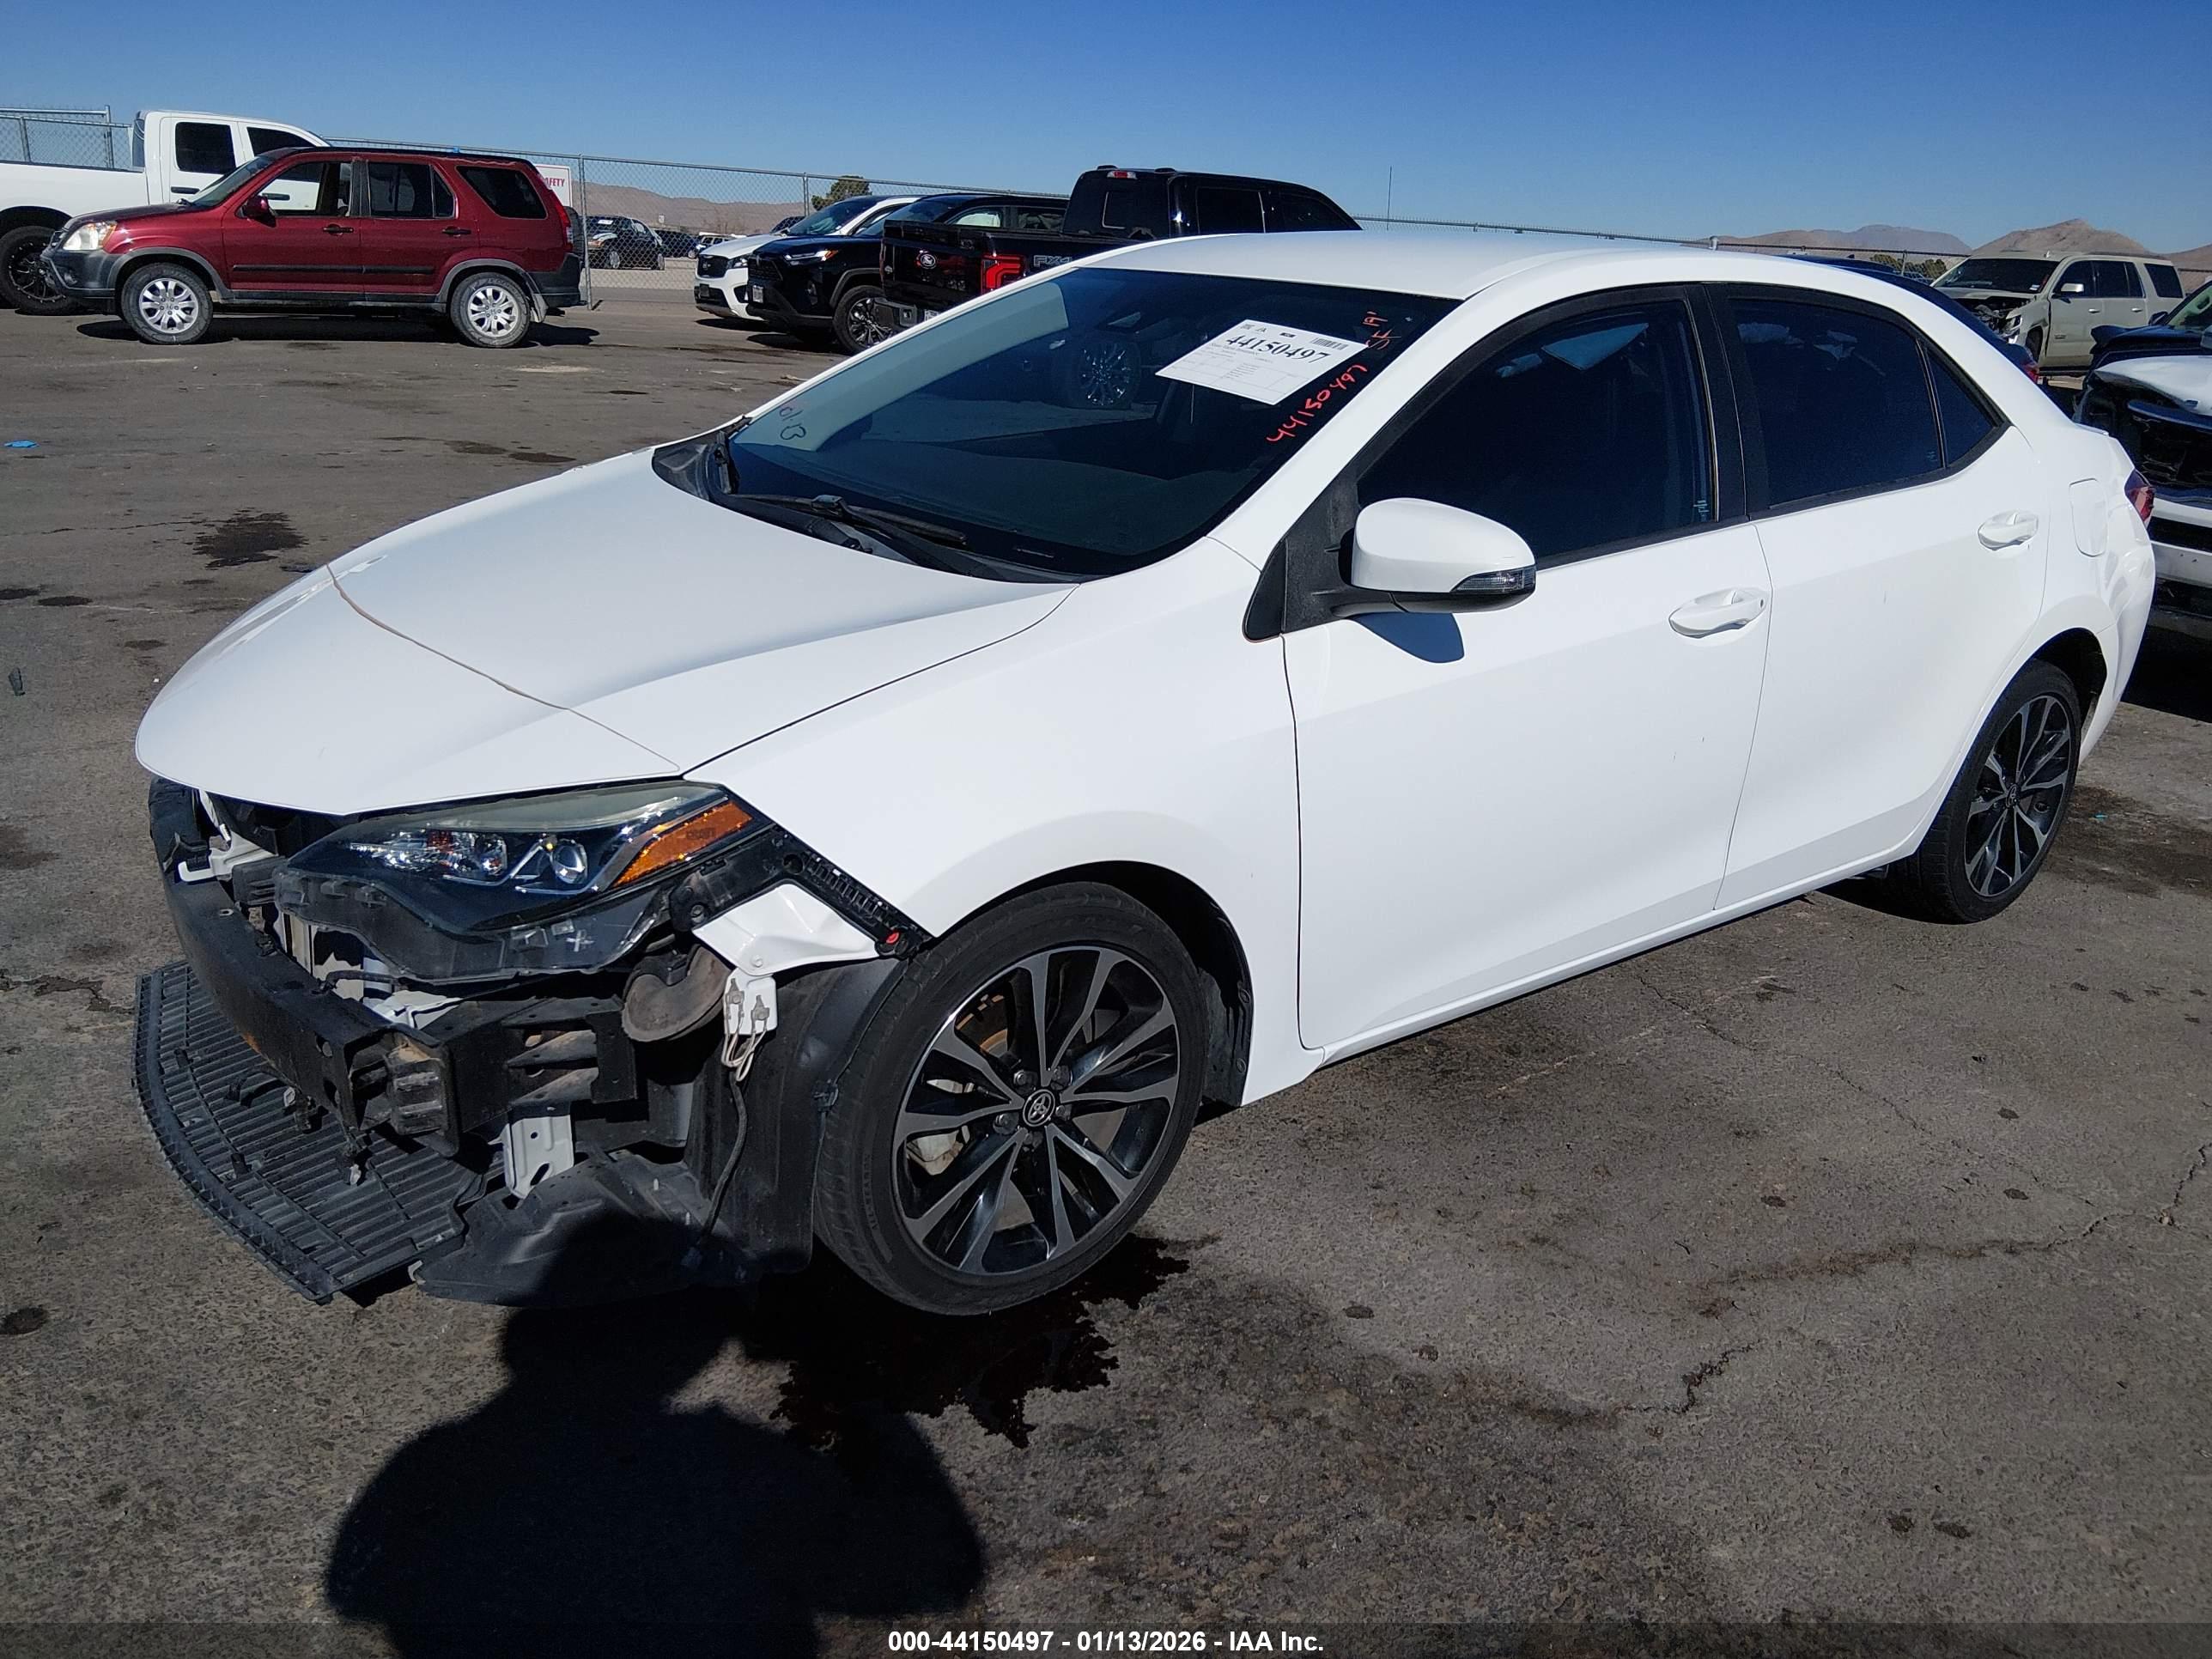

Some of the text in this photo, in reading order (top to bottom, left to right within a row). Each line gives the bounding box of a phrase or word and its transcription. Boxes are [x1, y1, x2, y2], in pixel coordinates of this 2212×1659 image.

[544, 177, 565, 187] AFETY
[1226, 335, 1331, 364] 44150497
[1266, 364, 1368, 441] 44150497
